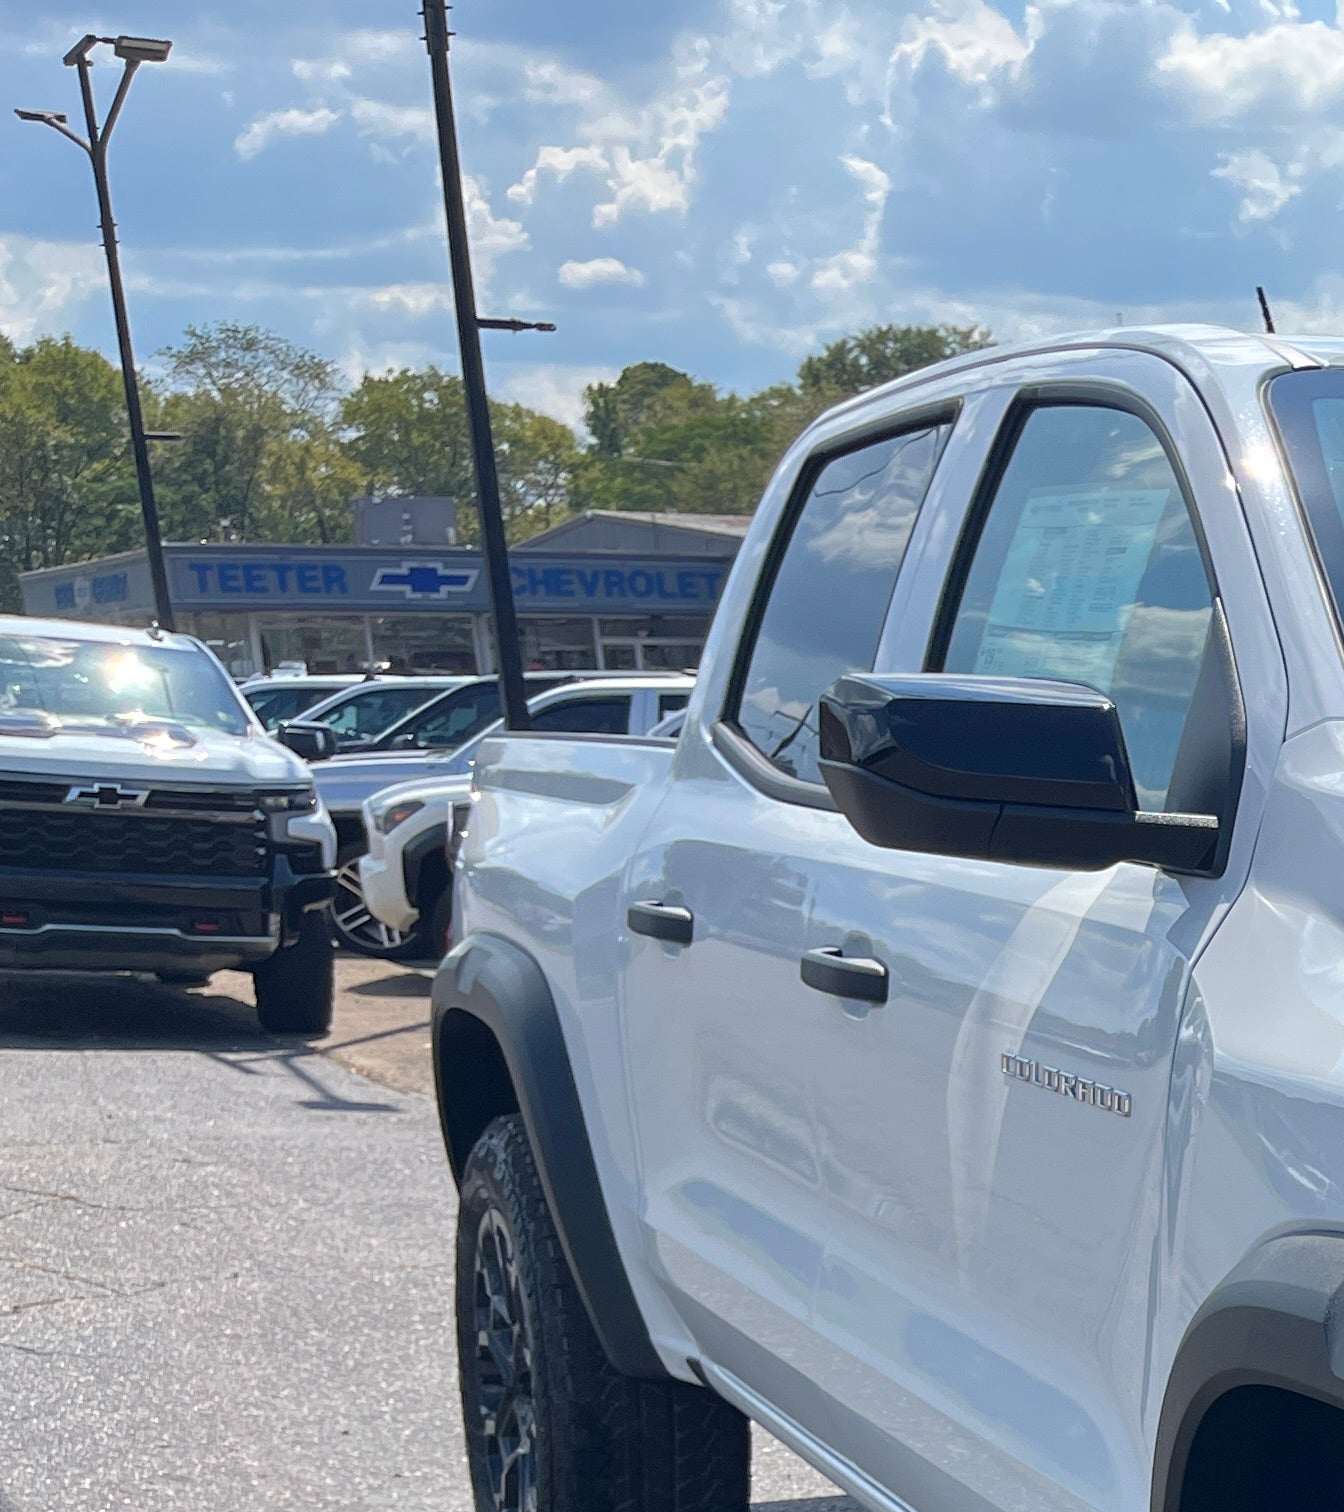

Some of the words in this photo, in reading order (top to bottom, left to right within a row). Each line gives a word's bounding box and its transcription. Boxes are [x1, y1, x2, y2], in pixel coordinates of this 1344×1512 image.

[188, 562, 348, 594] TEETER
[510, 565, 720, 599] CHEVROLET
[1001, 1052, 1132, 1118] COLORADO
